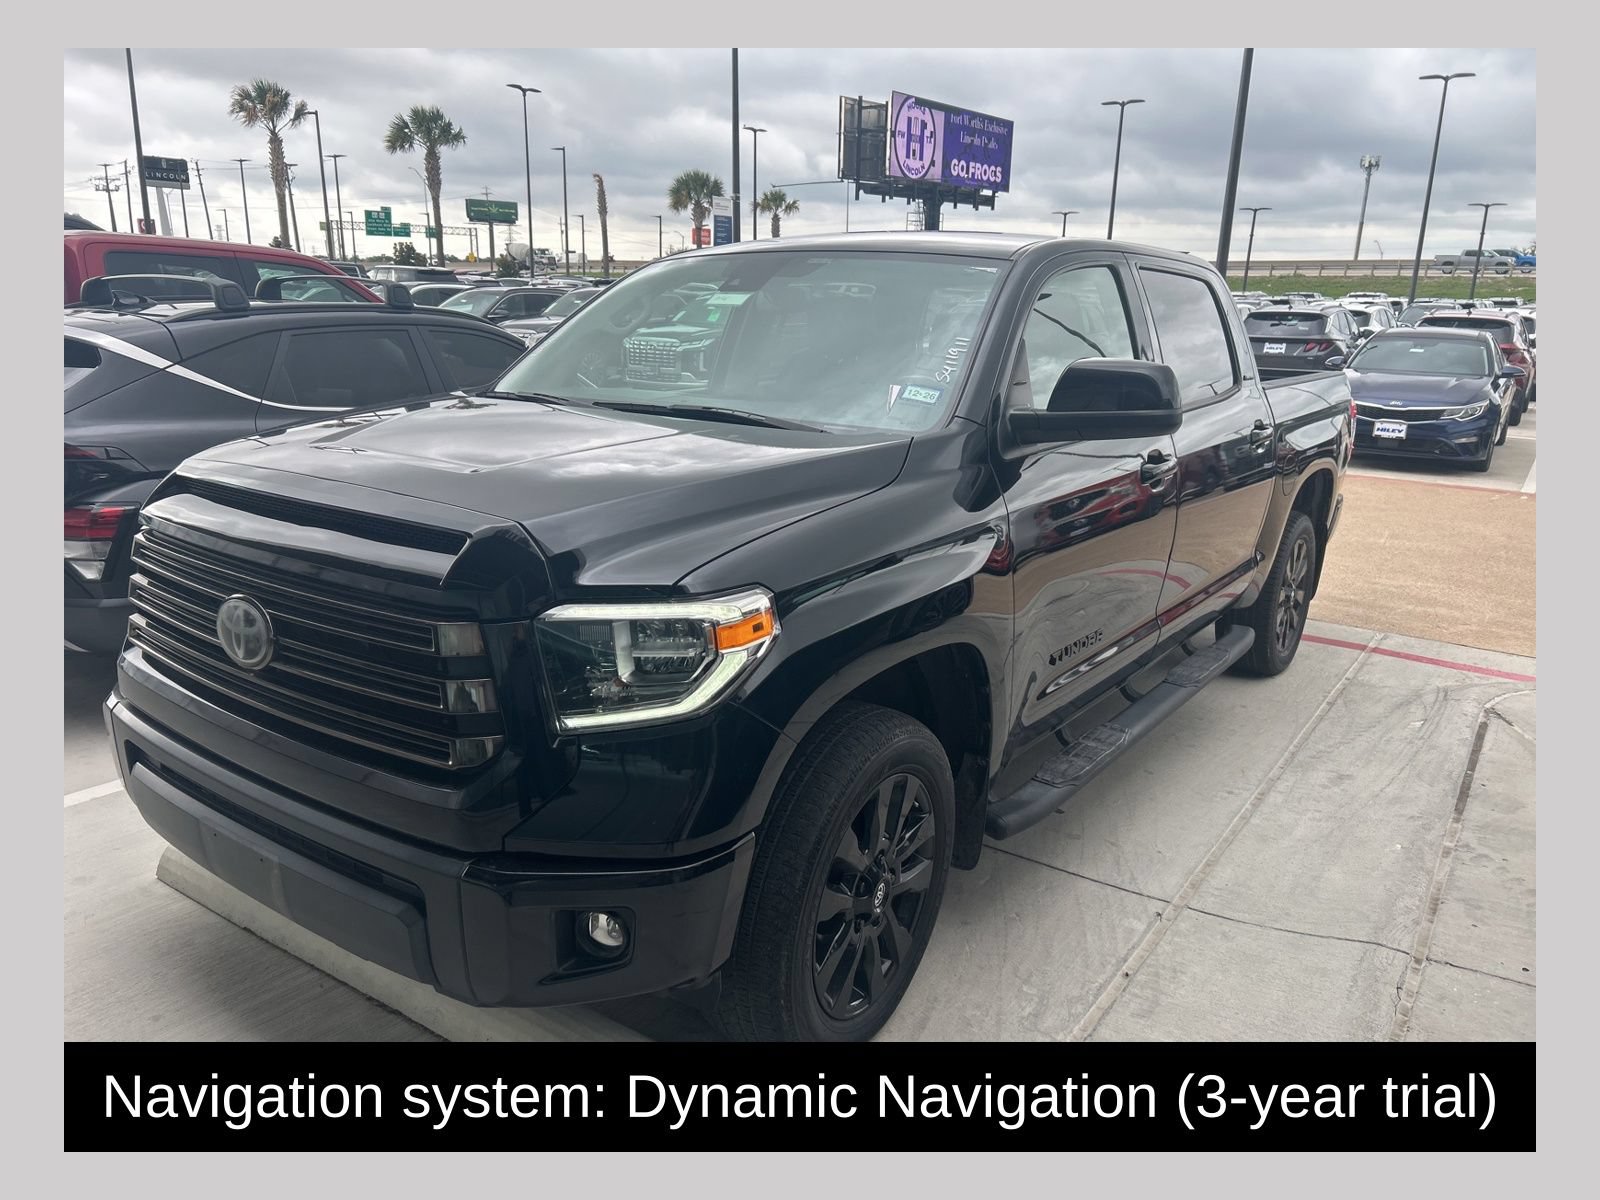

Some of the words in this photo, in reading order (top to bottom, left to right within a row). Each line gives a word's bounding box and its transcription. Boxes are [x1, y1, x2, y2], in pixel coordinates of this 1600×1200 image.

[903, 160, 926, 176] LINCOLN
[145, 171, 186, 180] LINCOLN
[1376, 426, 1404, 434] HILEY
[1048, 628, 1102, 666] TUNDRA
